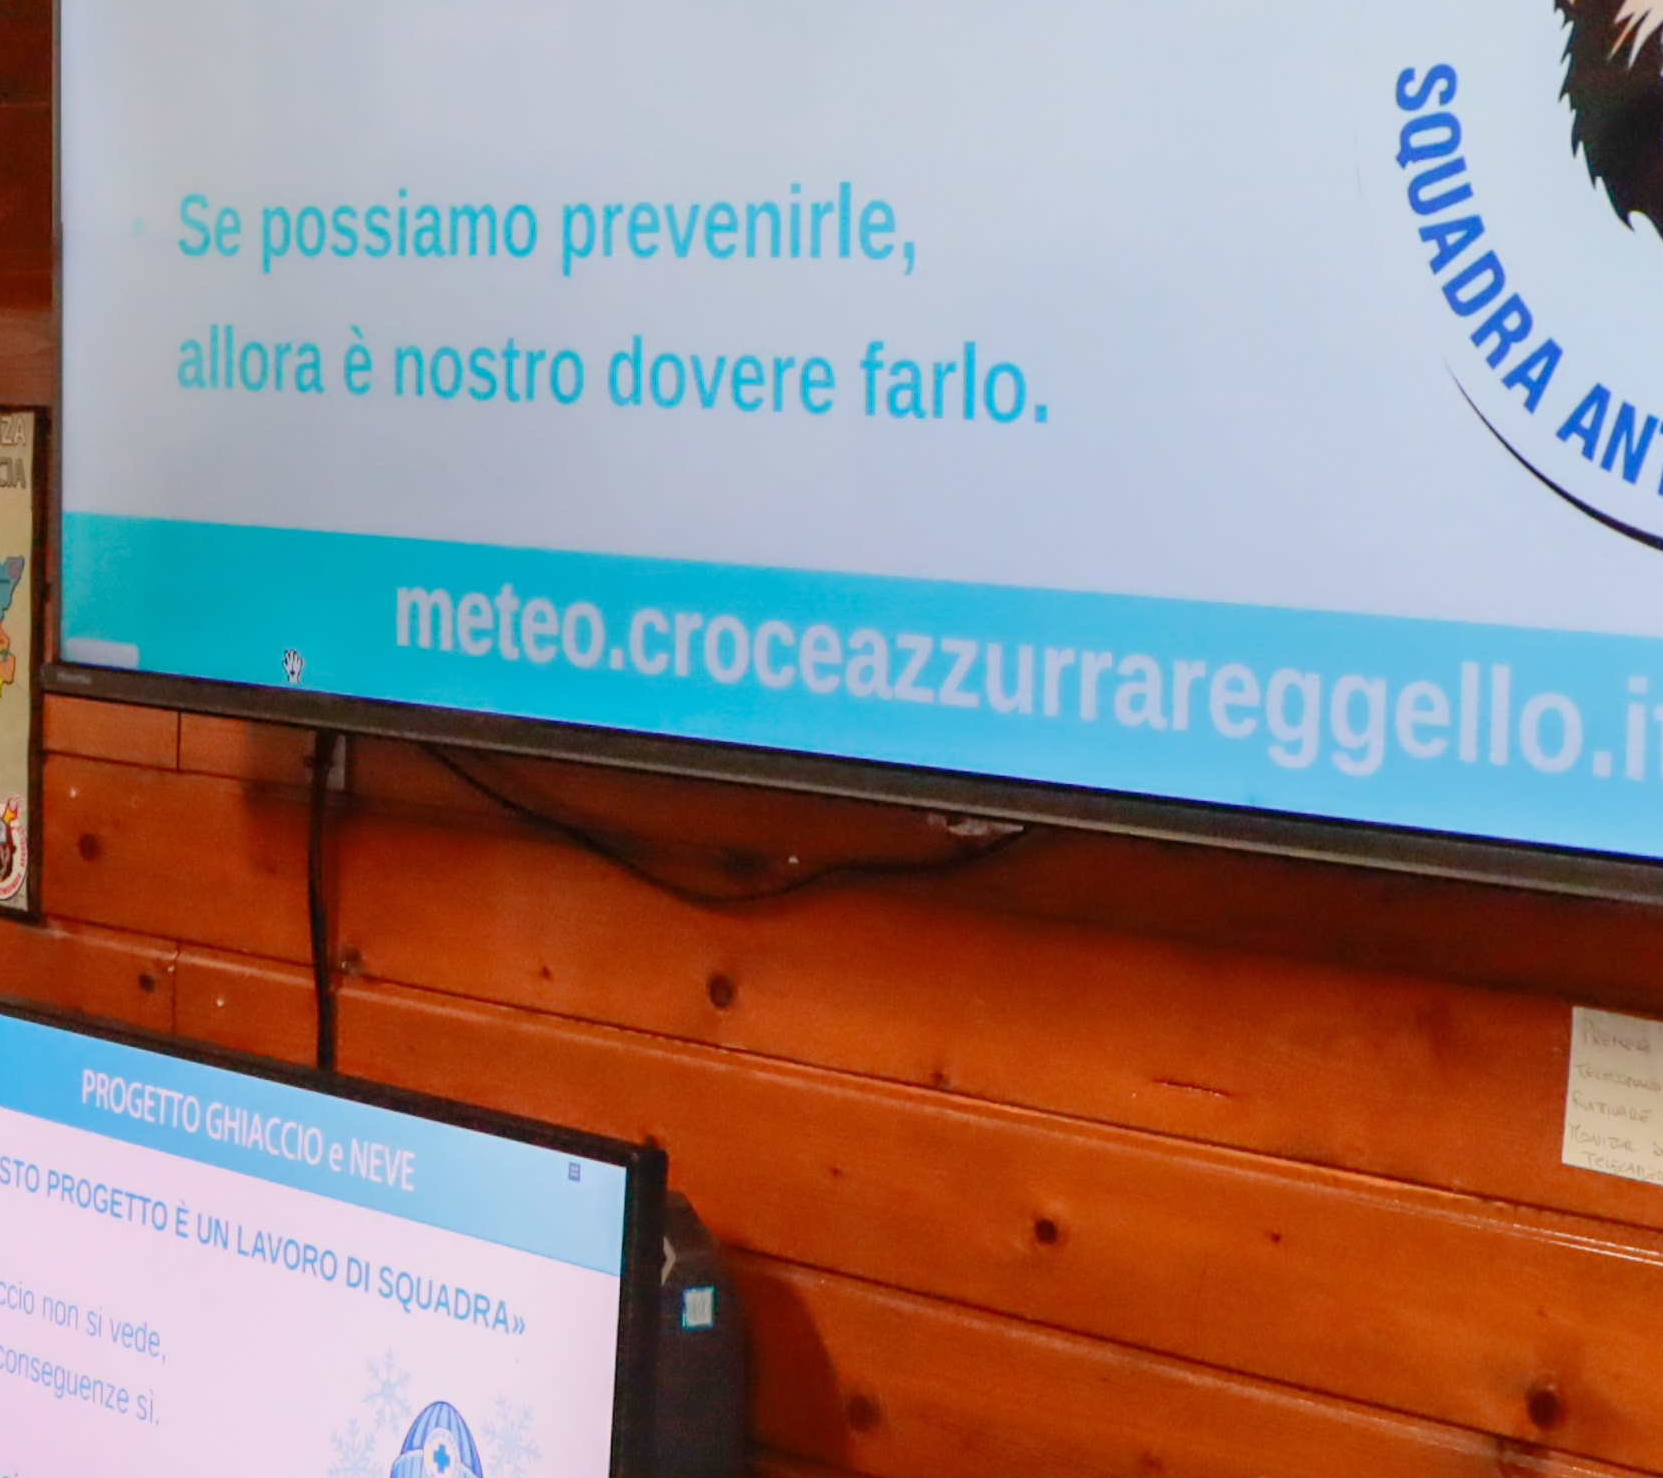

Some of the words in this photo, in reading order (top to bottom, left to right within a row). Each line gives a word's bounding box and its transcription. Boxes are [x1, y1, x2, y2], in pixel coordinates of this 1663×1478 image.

[177, 192, 242, 259] Se
[259, 188, 538, 274] possiamo
[561, 182, 917, 279] prevenirle,
[1393, 63, 1566, 414] SQUADRA
[176, 324, 325, 394] allora
[343, 326, 373, 396] è
[393, 331, 585, 406] nostro
[607, 334, 836, 416] dovere
[861, 339, 1052, 426] farlo.
[81, 1068, 200, 1133] PROGETTO
[205, 1101, 324, 1166] GHIACCIO
[328, 1142, 343, 1171] e
[350, 1137, 416, 1192] NEVE
[47, 1172, 168, 1231] PROGETTO
[175, 1200, 190, 1238] È
[197, 1212, 230, 1249] UN
[236, 1224, 338, 1282] LAVORO
[346, 1256, 371, 1293] DI
[377, 1266, 527, 1337] SQUADRA»
[41, 1295, 80, 1331] non
[85, 1305, 103, 1339] si
[108, 1308, 167, 1364] vede,
[135, 1385, 160, 1427] sì.
